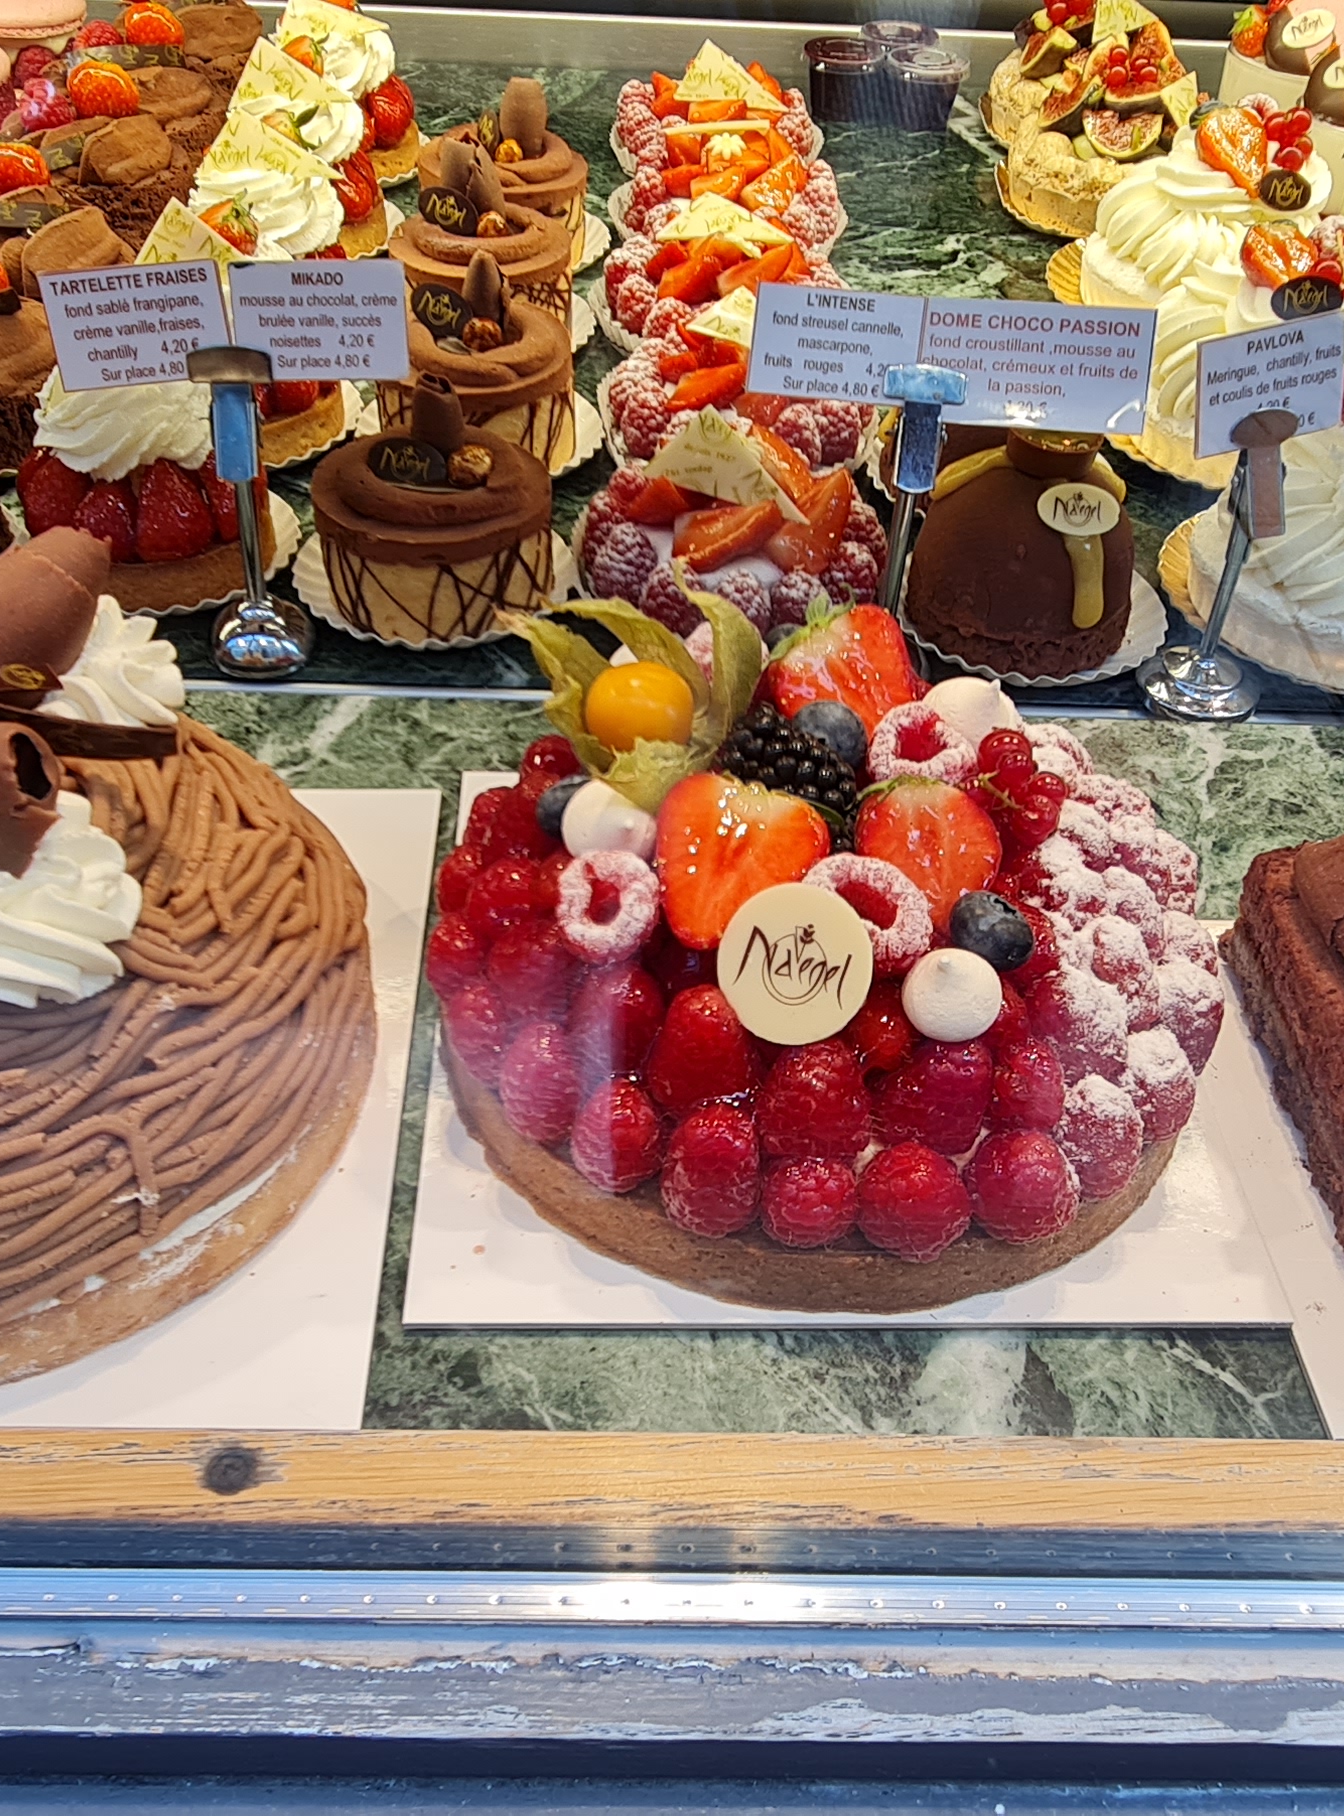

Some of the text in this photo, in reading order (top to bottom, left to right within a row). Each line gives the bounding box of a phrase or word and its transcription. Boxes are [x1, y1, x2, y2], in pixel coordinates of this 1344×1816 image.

[49, 267, 207, 296] TARTELETTE FRAISES
[291, 272, 344, 286] MIKADO
[64, 294, 204, 318] fond sablé frangipane,
[239, 293, 397, 308] mousse au chocolat, crème
[807, 293, 876, 312] L'INTENSE
[258, 314, 381, 328] brulée vanille, succès
[772, 311, 798, 327] fond
[801, 316, 848, 332] streusel
[851, 321, 904, 338] cannelle,
[929, 311, 1142, 337] DOME CHOCO PASSION
[73, 325, 112, 341] crème
[269, 334, 375, 348] noisettes 4,20 €
[1246, 330, 1304, 355] PAVLOVA
[87, 337, 199, 362] chantilly 4,20 €
[797, 337, 873, 356] mascarpone,
[929, 334, 961, 348] fond
[965, 338, 1045, 354] croustillant
[1116, 346, 1136, 359] au
[101, 361, 185, 382] Sur place 4,80
[277, 354, 371, 370] Sur place 4,80 €
[764, 353, 792, 367] fruits
[803, 358, 844, 374] rouges
[992, 358, 1056, 375] crémeux
[1060, 363, 1075, 376] et
[1078, 363, 1115, 379] fruits
[1119, 365, 1138, 379] de
[1207, 344, 1342, 386] Meringue, chantilly, fruits
[783, 375, 880, 397] Sur place 4,80 €
[987, 378, 1067, 398] la passion,
[1209, 368, 1337, 406] et coulis de fruits rouges
[1283, 396, 1291, 409] €
[1307, 412, 1315, 425] €
